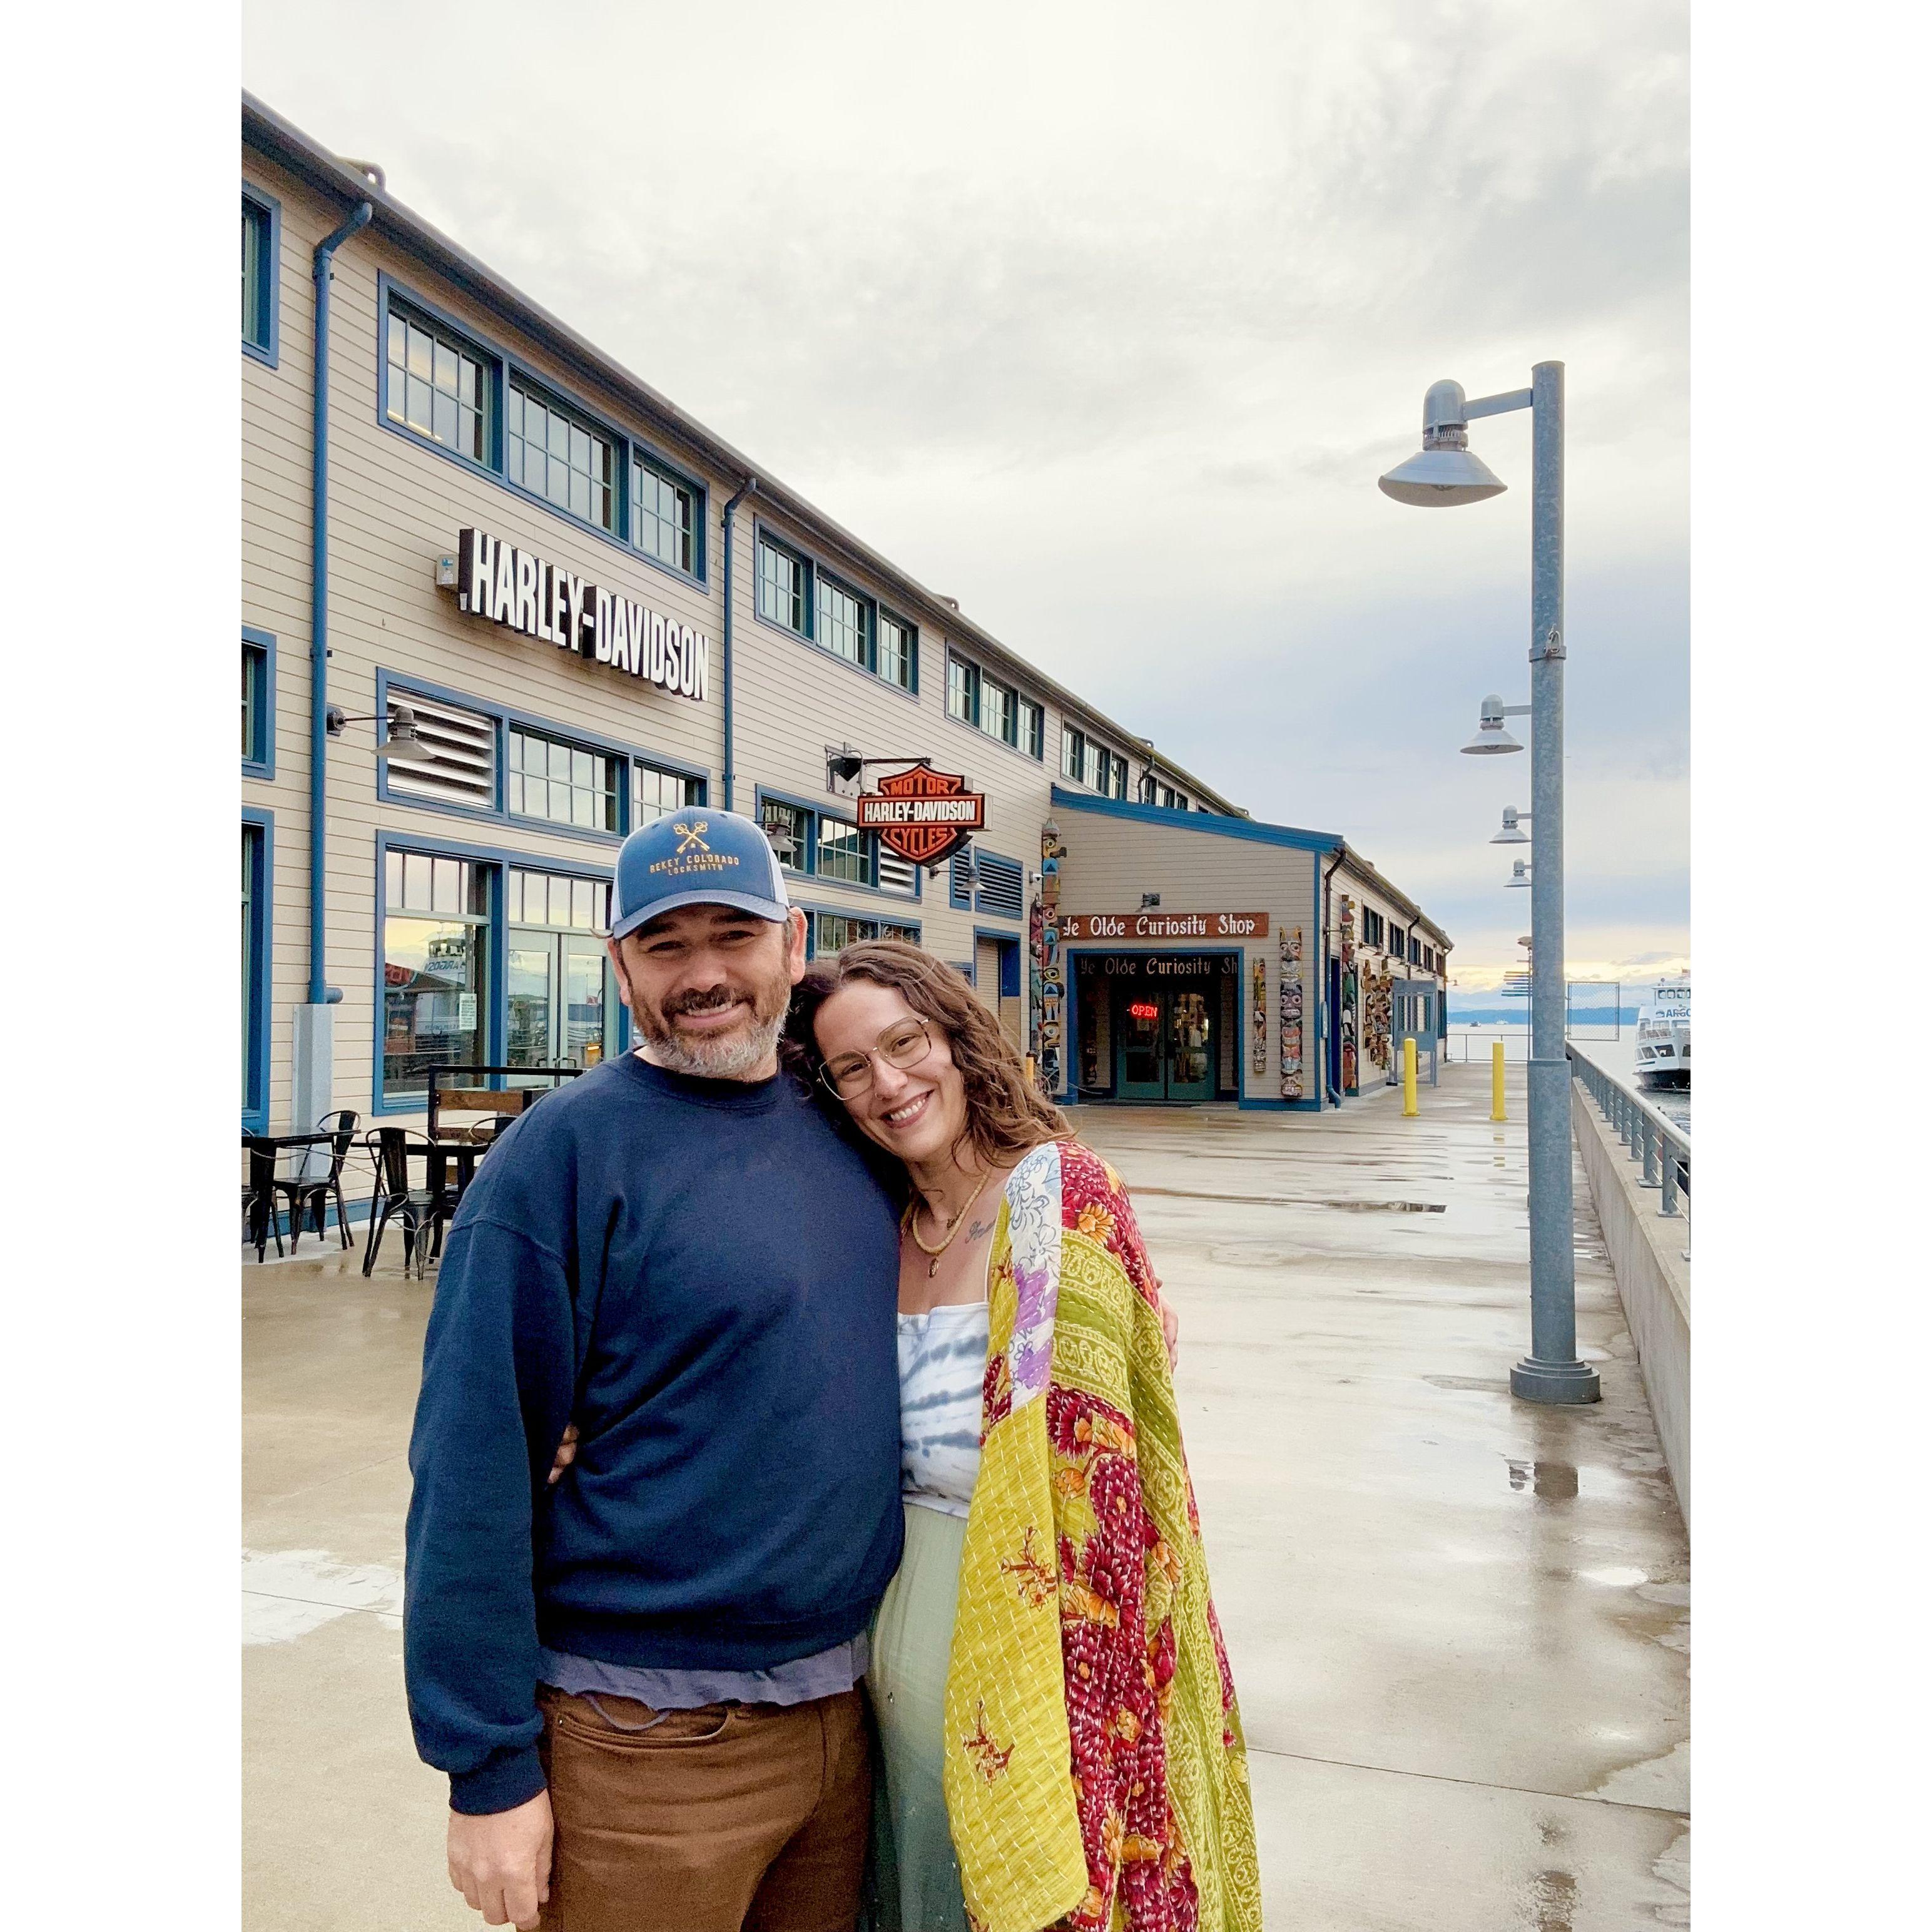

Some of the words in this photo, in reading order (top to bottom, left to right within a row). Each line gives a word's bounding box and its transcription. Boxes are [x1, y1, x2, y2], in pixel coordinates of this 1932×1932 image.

[472, 527, 709, 701] HARLEY-DAVIDSON
[891, 772, 948, 795] MOTOR
[864, 801, 975, 822] HARLEY-DAVIDSON
[890, 828, 947, 855] CYCLES
[668, 864, 723, 875] LOCKSMITH
[686, 854, 740, 865] COLORADO
[1091, 916, 1126, 936] Olde
[1136, 915, 1208, 935] Curiosity
[1218, 913, 1256, 935] Shop
[1080, 957, 1095, 975] Ye
[1105, 957, 1136, 975] Olde
[1146, 957, 1211, 975] Curiosity
[1131, 1004, 1158, 1018] OPEN
